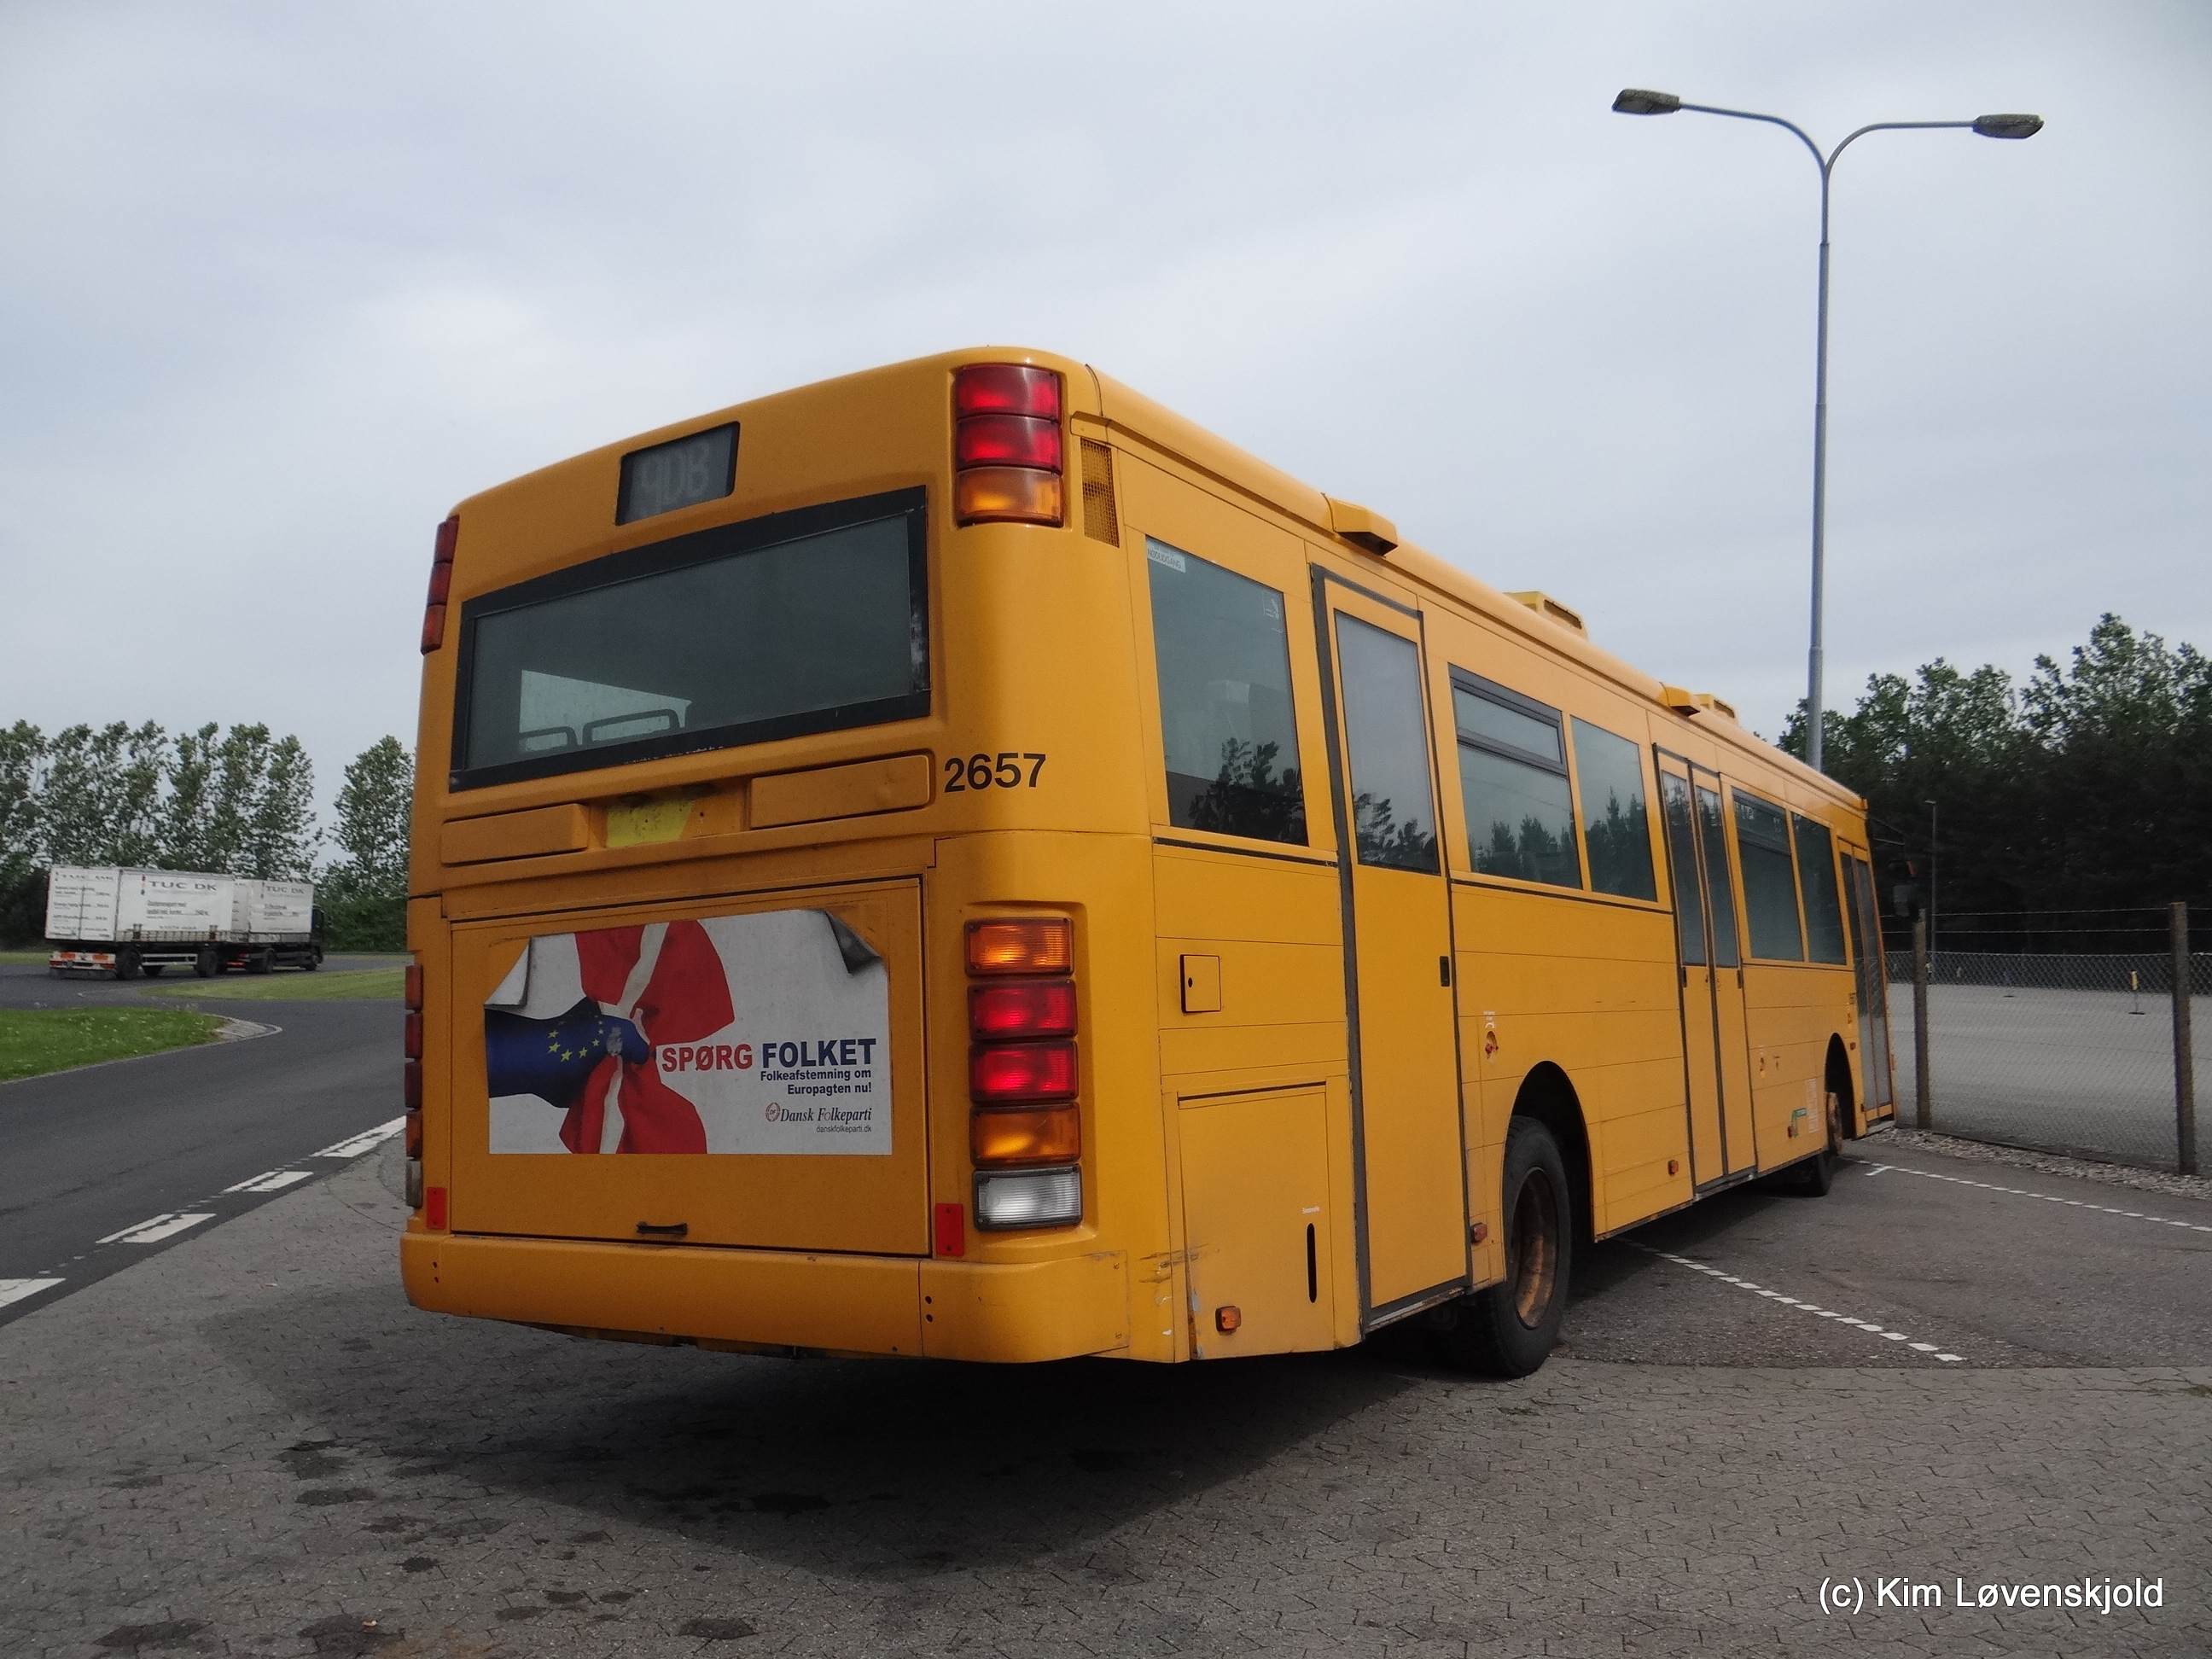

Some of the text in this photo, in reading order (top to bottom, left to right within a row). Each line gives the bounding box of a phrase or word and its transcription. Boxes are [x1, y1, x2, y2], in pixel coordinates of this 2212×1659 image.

[944, 752, 1046, 793] 2657
[148, 880, 188, 888] TUC
[661, 1038, 876, 1073] SPØRG FOLKET
[760, 1068, 871, 1081] Folkeafstemning om
[787, 1082, 872, 1097] Europagten nu!
[780, 1108, 872, 1125] Dansk Folkeparti
[816, 1124, 872, 1134] danskfolkeparti.dk
